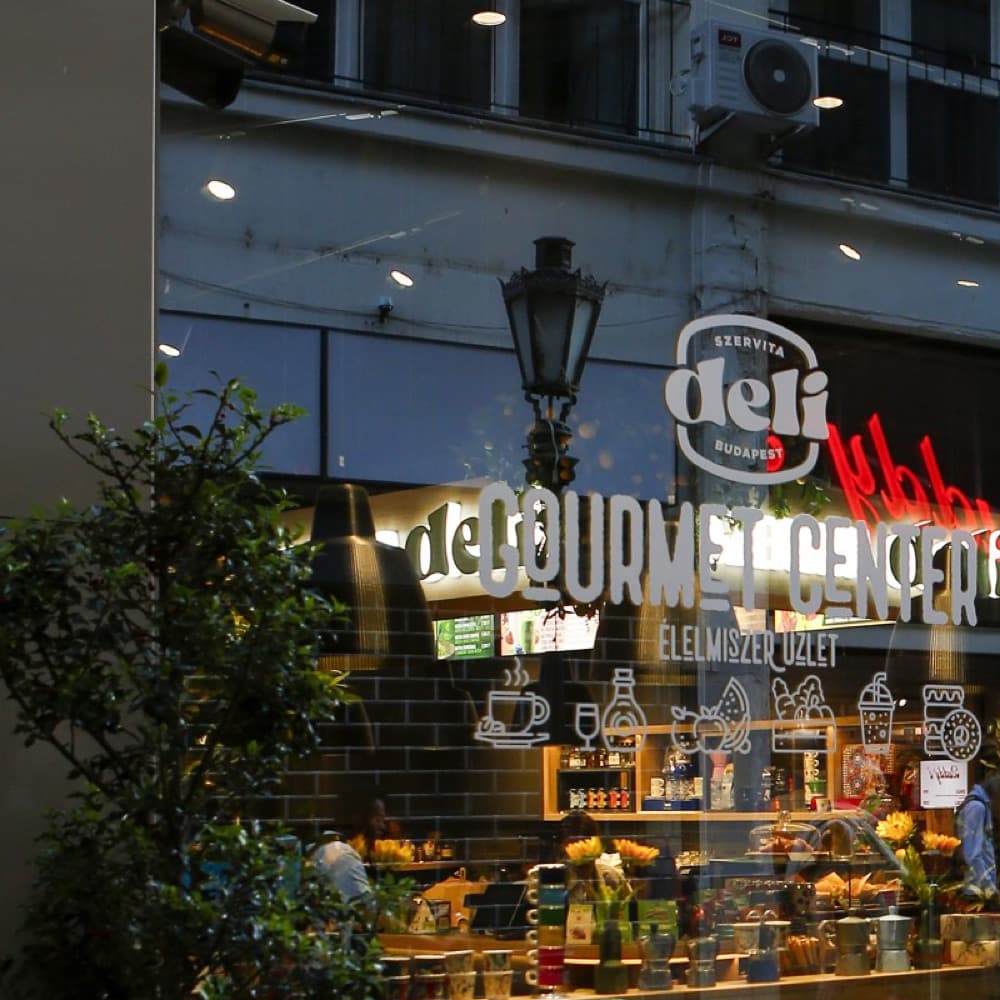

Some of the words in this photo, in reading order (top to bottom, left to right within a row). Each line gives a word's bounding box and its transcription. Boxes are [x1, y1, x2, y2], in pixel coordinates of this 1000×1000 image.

[714, 335, 785, 358] SZERVITA
[665, 357, 829, 440] deli
[714, 439, 784, 460] BUDAPEST
[479, 481, 763, 612] GOURMET
[789, 513, 978, 627] CENTER
[659, 619, 786, 673] ÉLELMISZER
